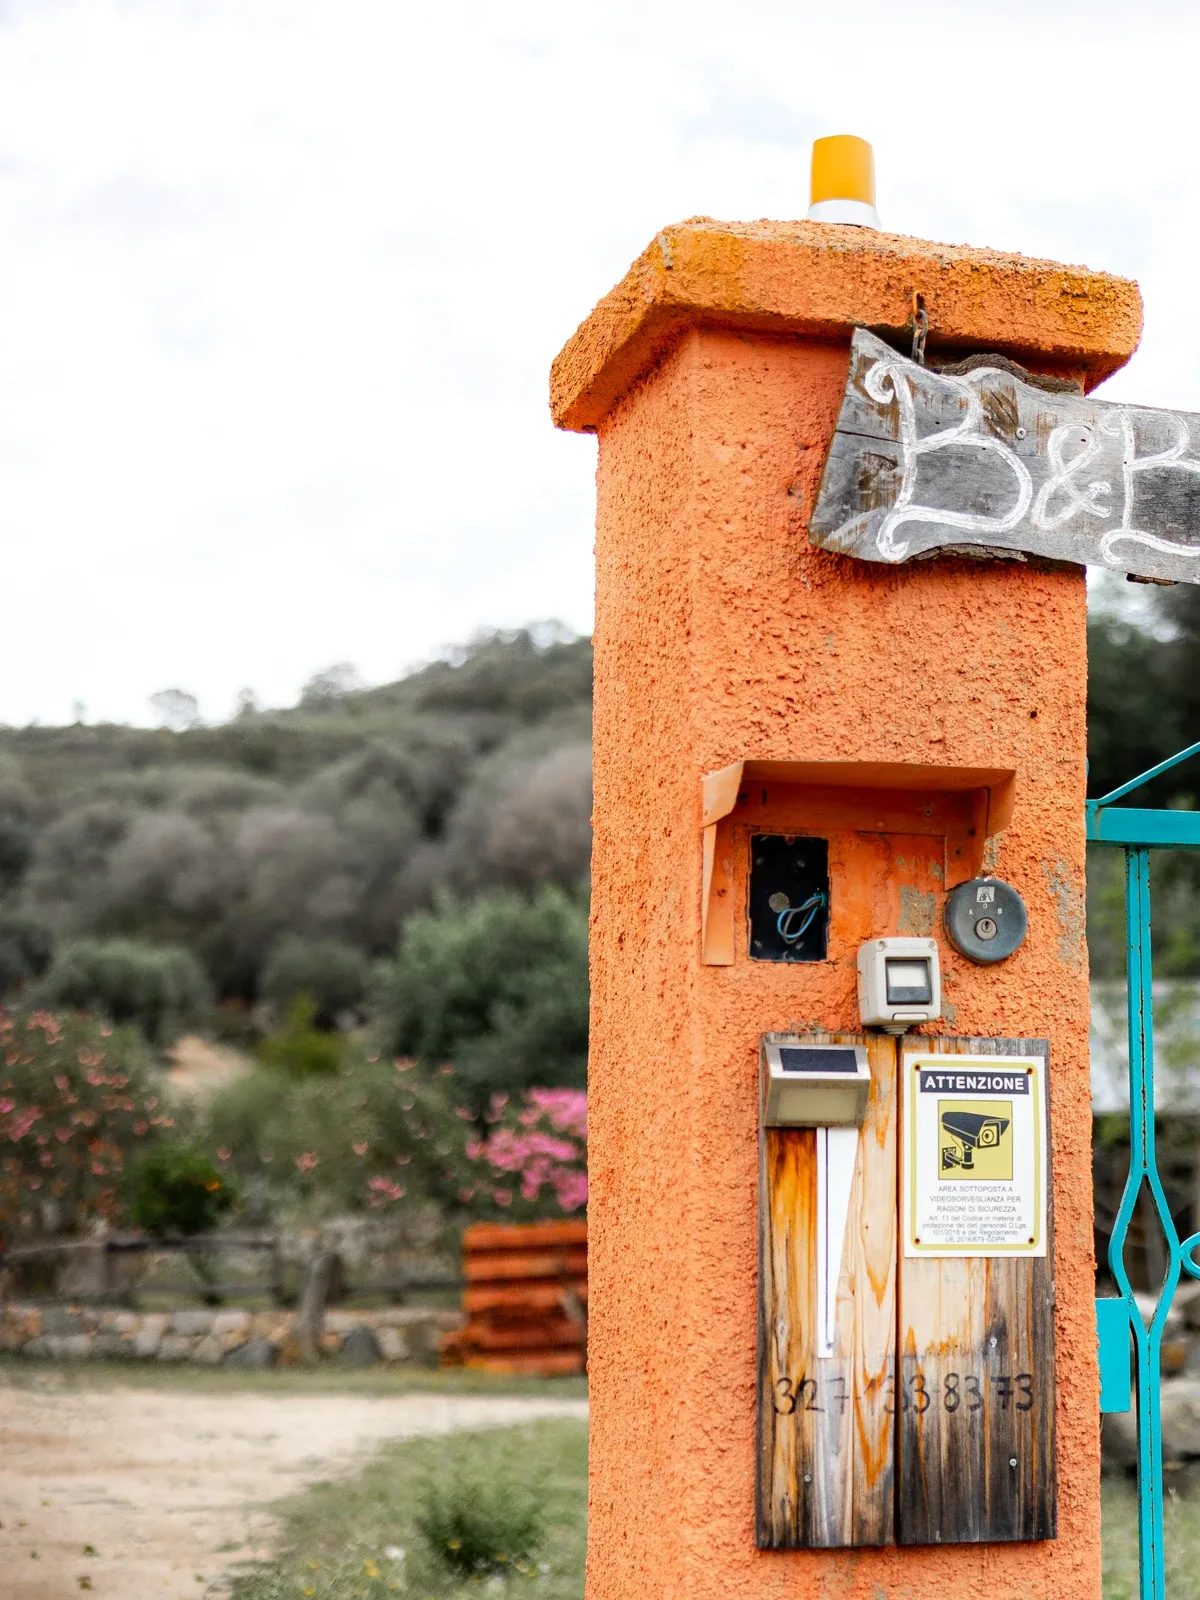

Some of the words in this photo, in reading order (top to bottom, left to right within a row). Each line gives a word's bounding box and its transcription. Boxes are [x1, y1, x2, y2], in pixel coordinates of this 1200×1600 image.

[925, 1075, 1025, 1091] ATTENZIONE
[922, 1222, 954, 1230] protezione
[979, 1222, 1007, 1230] personali
[979, 1229, 1019, 1237] Regolamento
